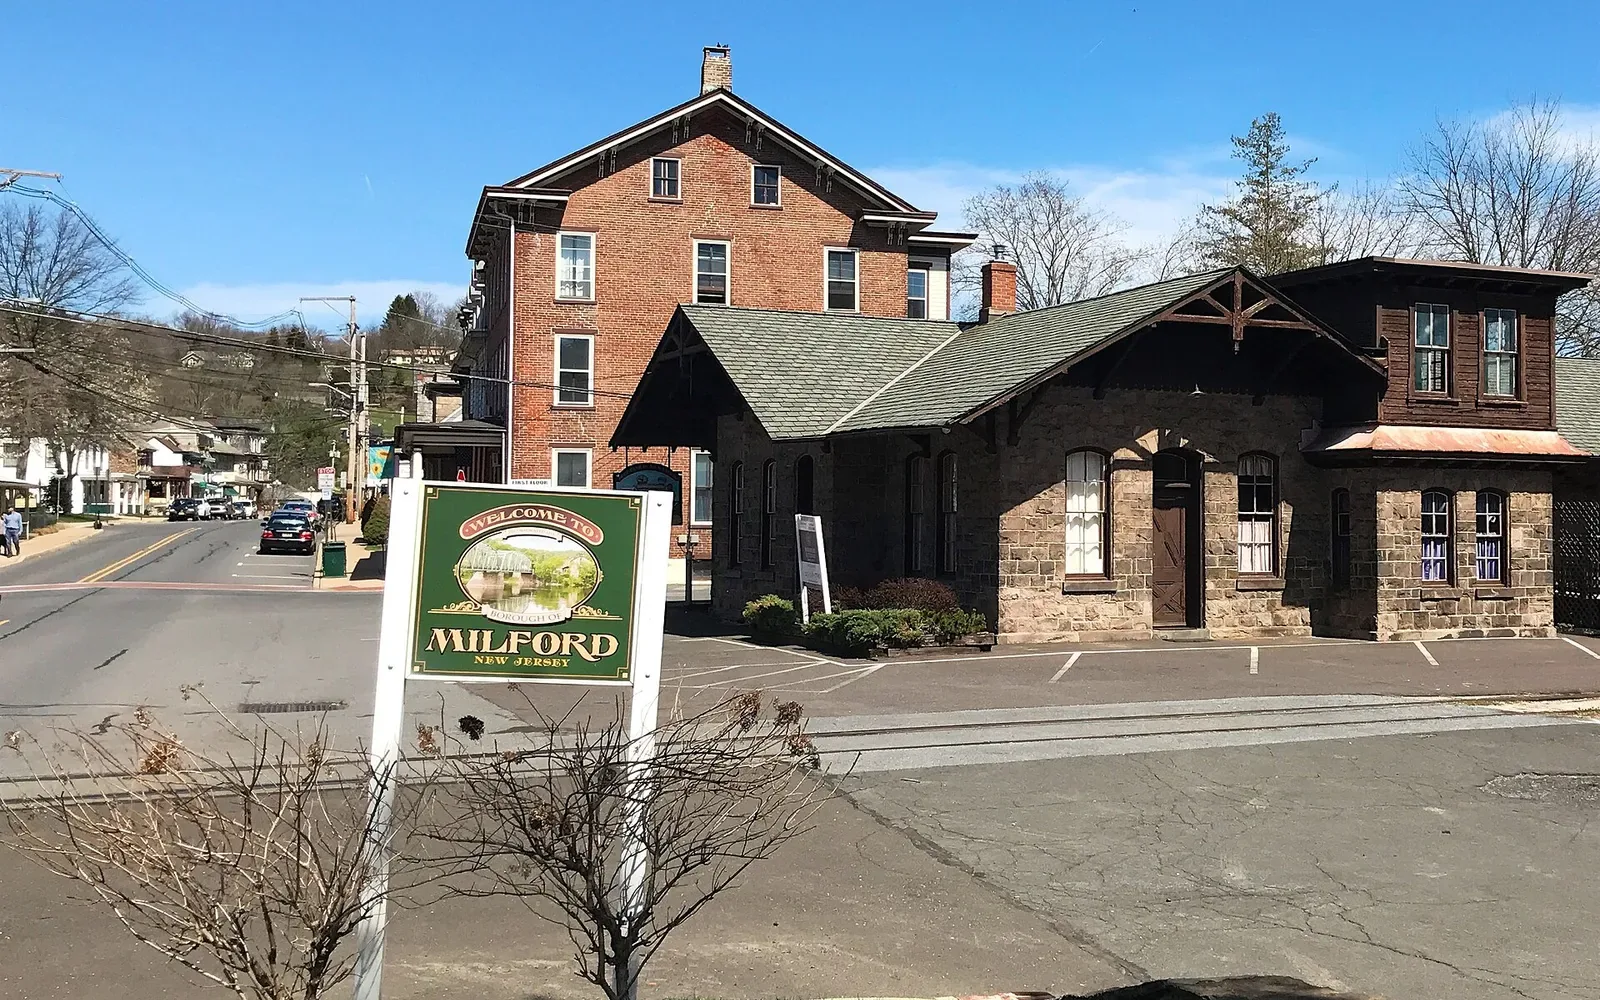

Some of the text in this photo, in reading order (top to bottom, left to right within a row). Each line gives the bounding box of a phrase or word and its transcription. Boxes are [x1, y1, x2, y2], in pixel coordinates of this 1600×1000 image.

[469, 508, 567, 532] WELCOME
[571, 518, 594, 538] TO
[490, 610, 564, 623] BOROUGH OF
[425, 628, 619, 662] MILFORD
[474, 655, 570, 667] NEW JERSEY
